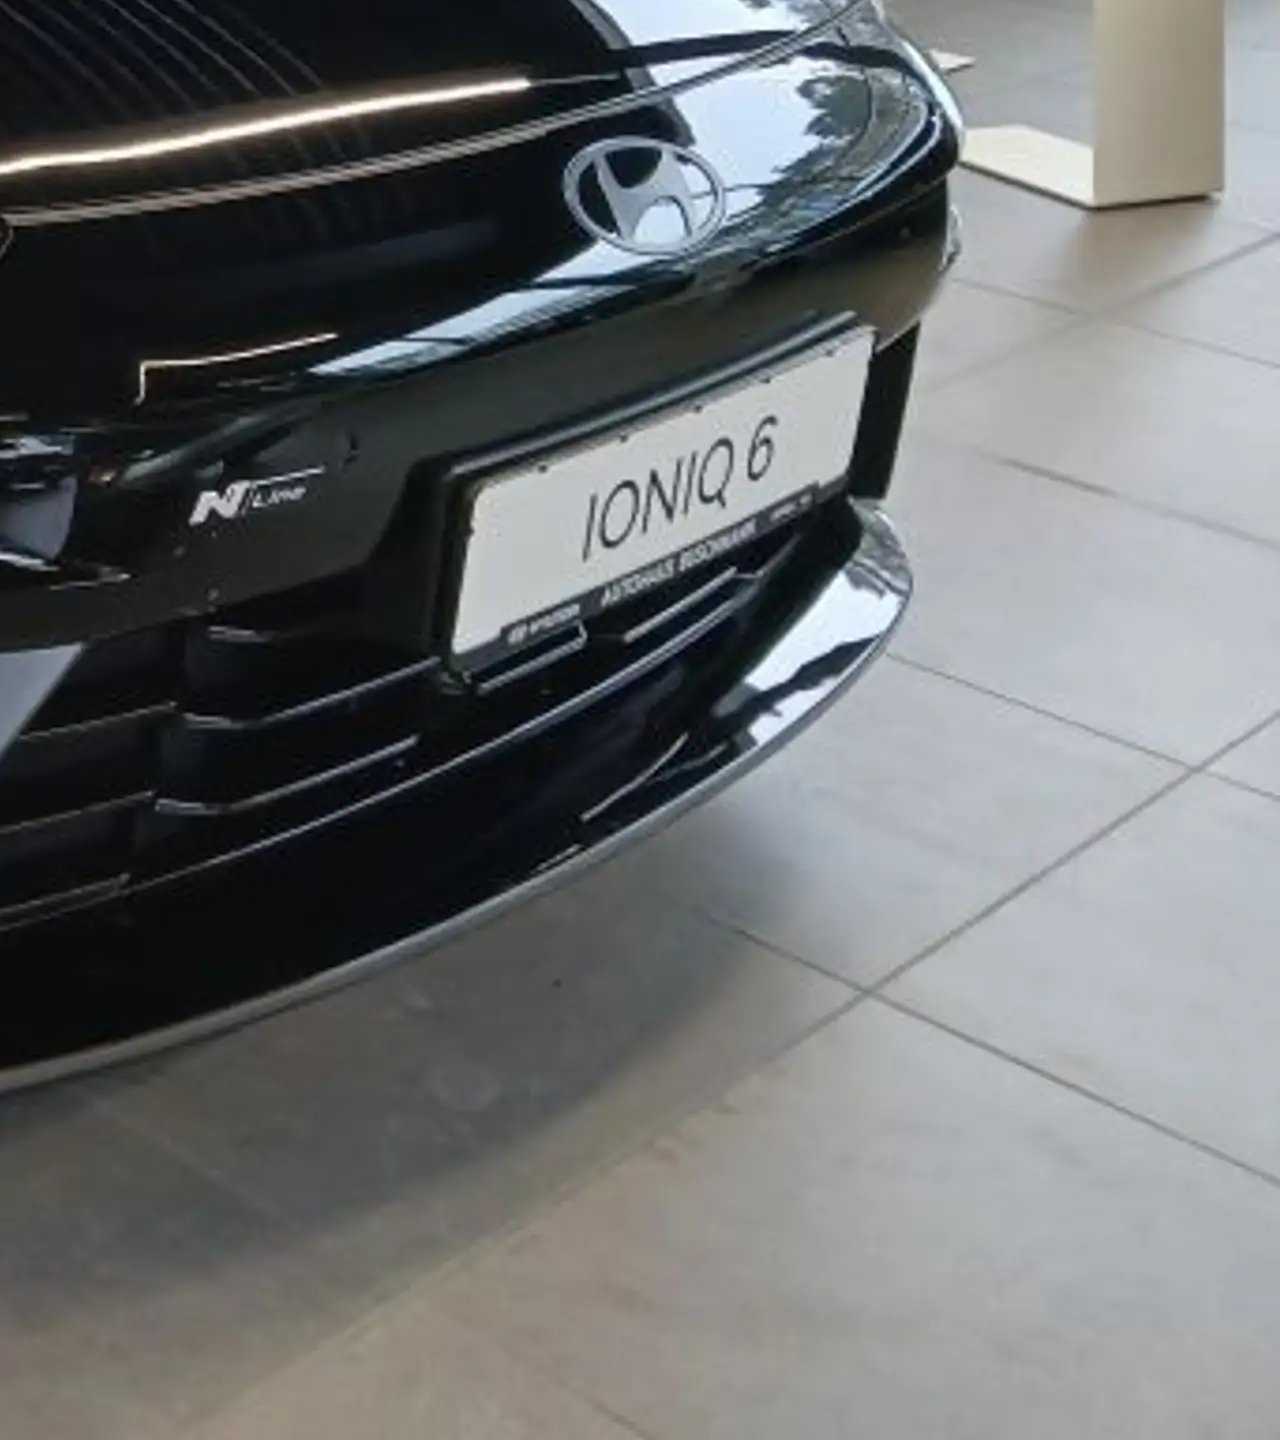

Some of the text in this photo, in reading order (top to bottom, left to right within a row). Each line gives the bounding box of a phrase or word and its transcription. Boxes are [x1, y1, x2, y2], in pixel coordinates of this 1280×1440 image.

[188, 480, 251, 526] N
[582, 414, 778, 562] IONIQ 6
